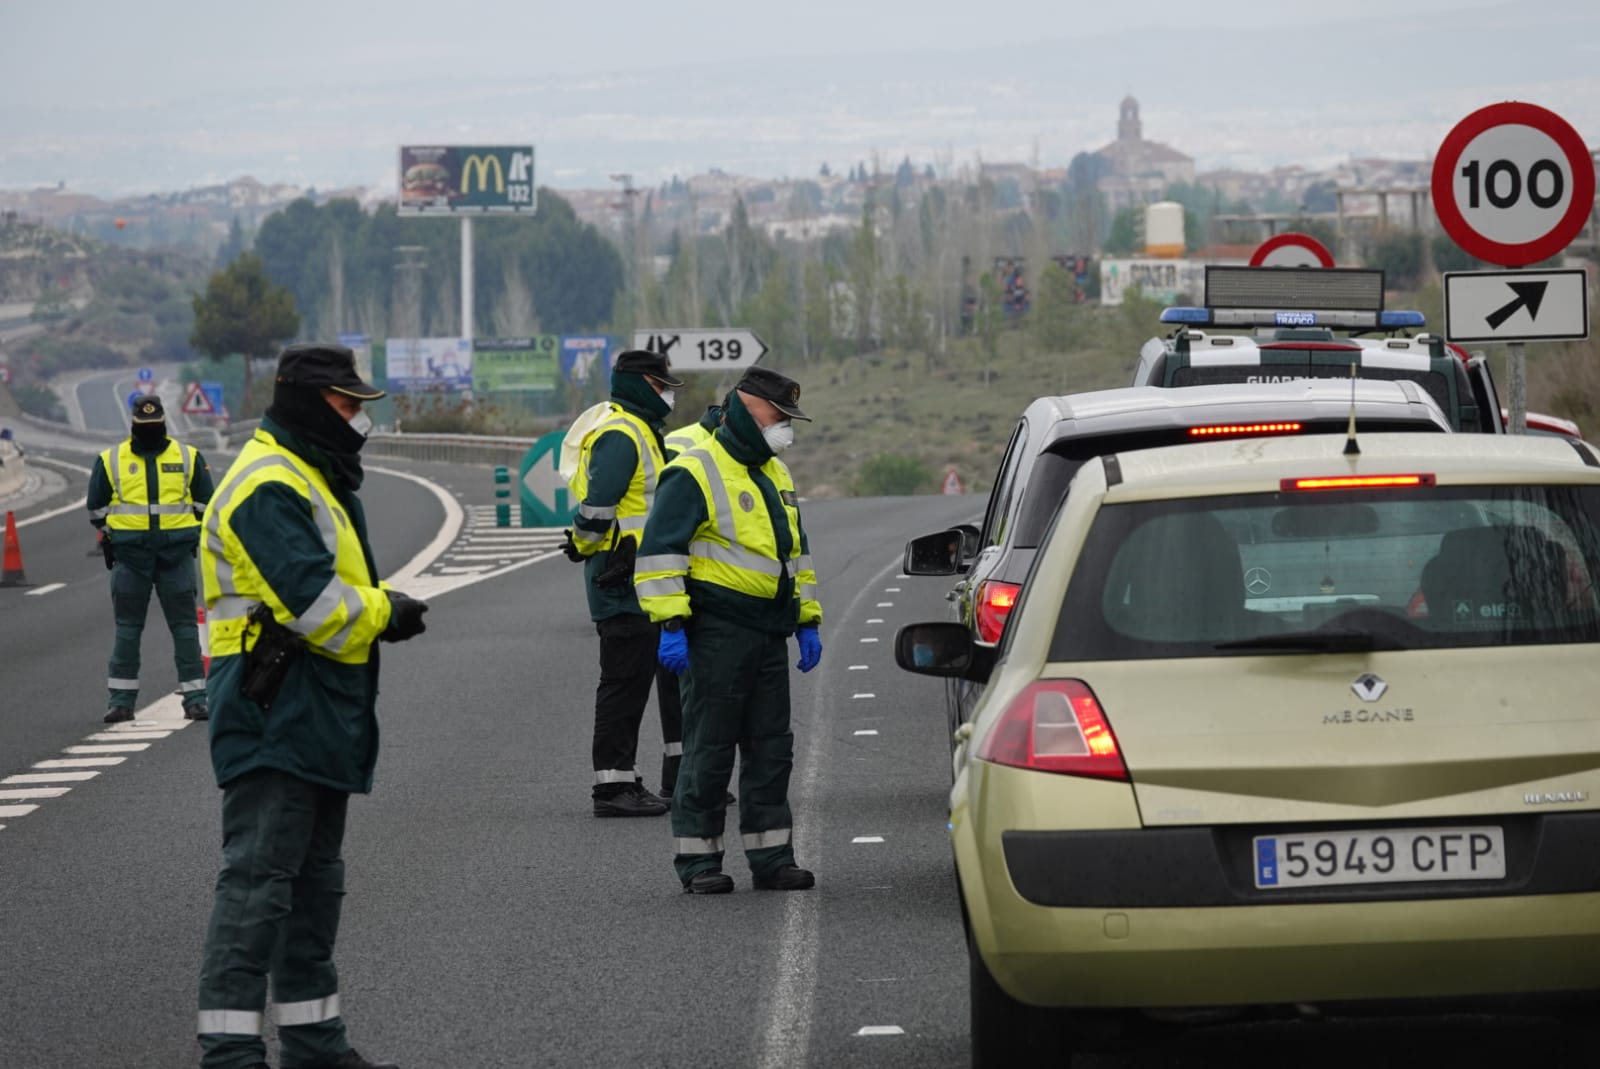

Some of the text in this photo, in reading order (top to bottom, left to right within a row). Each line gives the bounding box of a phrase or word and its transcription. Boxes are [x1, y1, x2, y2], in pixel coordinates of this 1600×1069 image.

[507, 184, 530, 202] 132
[1462, 159, 1564, 209] 100
[697, 339, 742, 361] 139
[1323, 708, 1414, 724] MEGANE
[1263, 833, 1493, 878] E 5949 CFP
